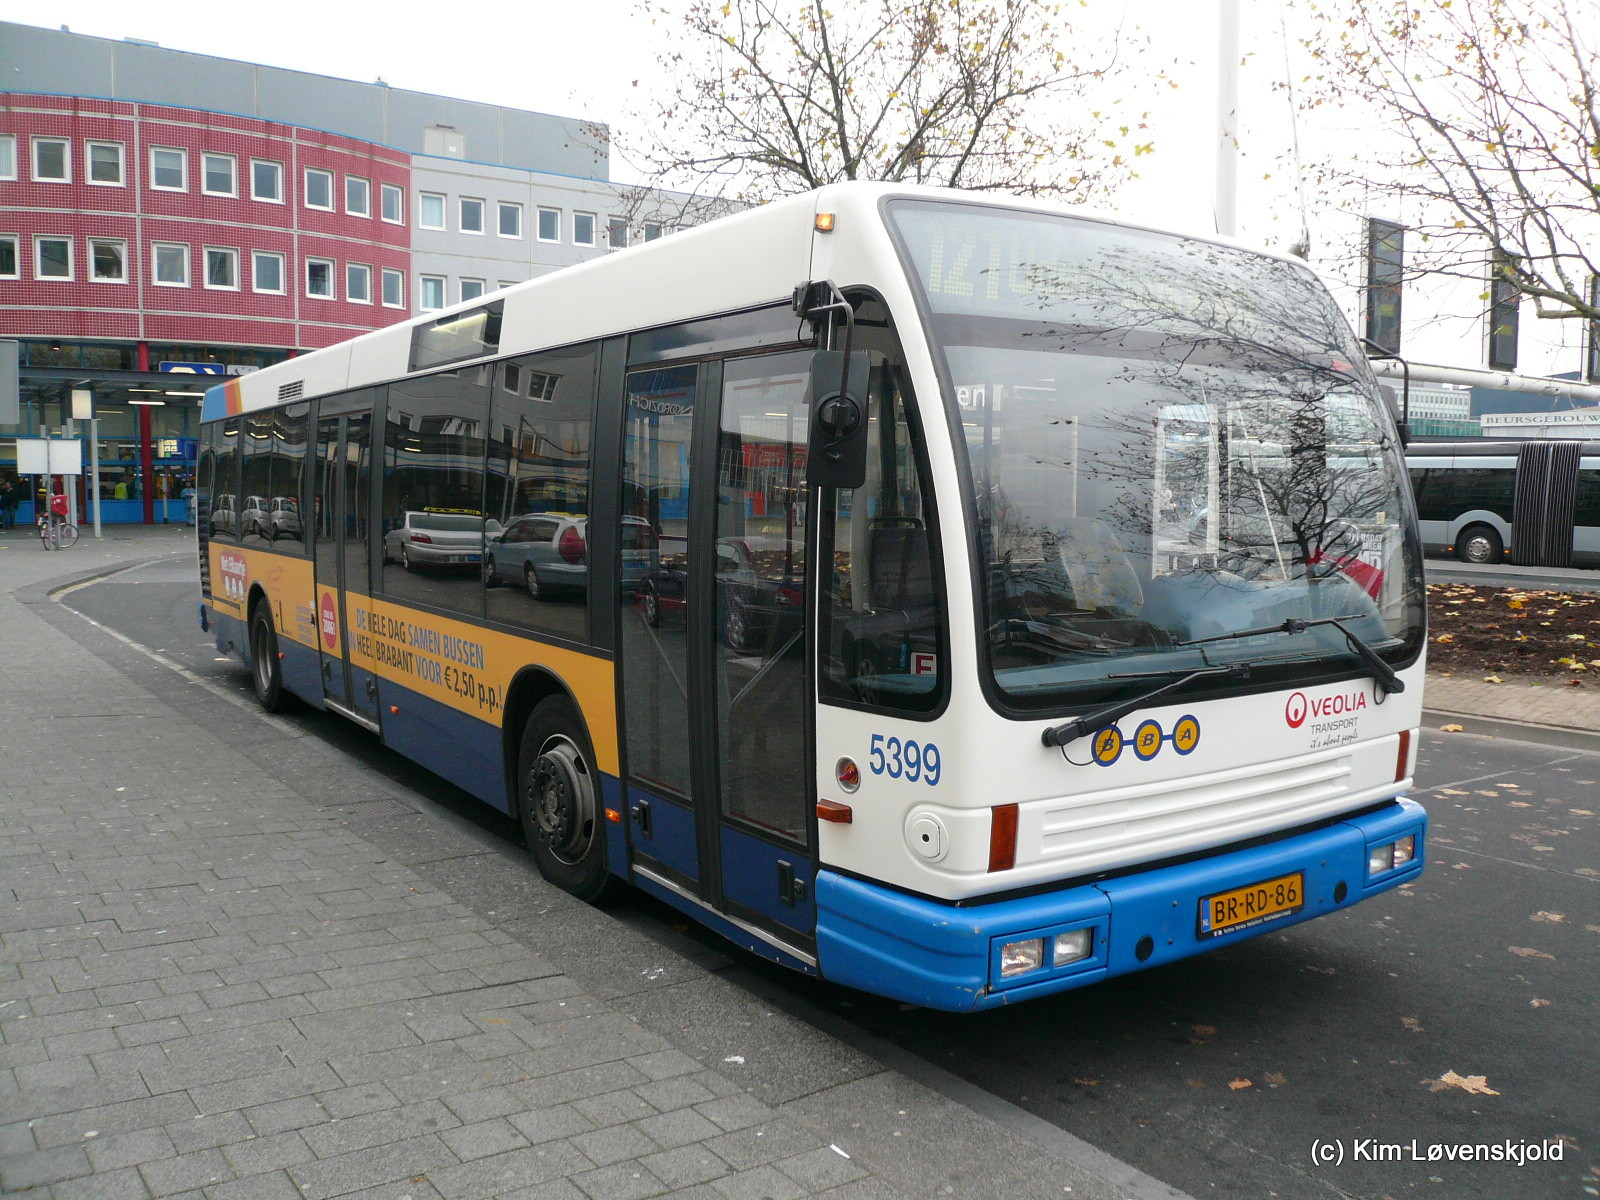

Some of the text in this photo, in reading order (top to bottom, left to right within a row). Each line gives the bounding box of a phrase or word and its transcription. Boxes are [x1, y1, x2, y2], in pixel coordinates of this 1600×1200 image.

[1486, 415, 1600, 424] BEURSGEBOUW
[356, 608, 367, 630] DE
[388, 617, 406, 644] DAG
[408, 623, 441, 656] SAMEN
[443, 634, 485, 670] BUSSEN
[356, 633, 374, 659] HEEL
[376, 640, 414, 674] BRABANT
[415, 653, 442, 686] VOOR
[453, 668, 475, 699] 2,50
[1311, 692, 1366, 717] VEOLIA
[1310, 717, 1358, 734] TRANSPORT
[1323, 734, 1340, 746] about
[1342, 728, 1358, 745] people
[869, 733, 941, 786] 5399
[1215, 881, 1297, 924] BR-RD-86
